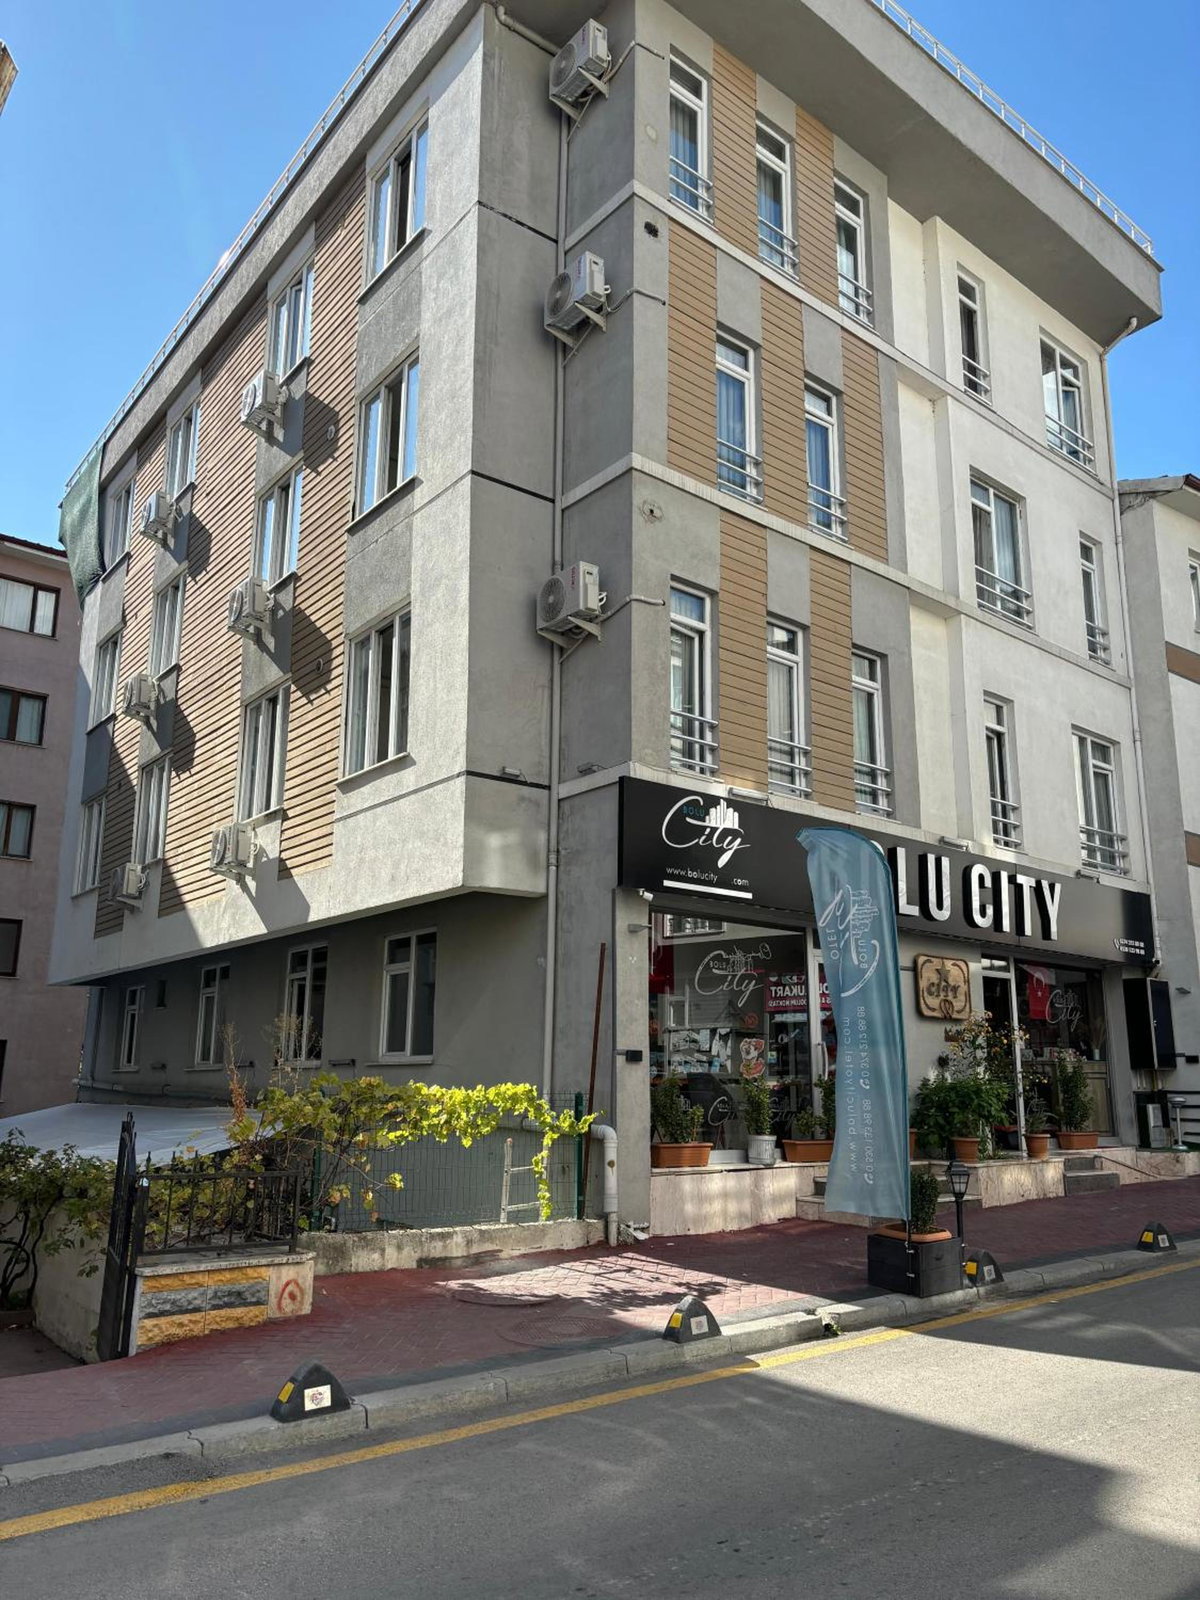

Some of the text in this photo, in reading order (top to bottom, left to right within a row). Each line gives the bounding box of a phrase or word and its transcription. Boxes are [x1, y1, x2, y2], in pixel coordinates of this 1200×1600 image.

[662, 795, 751, 868] City
[683, 805, 705, 816] BOLU
[666, 867, 718, 884] www.bolucity
[964, 863, 1061, 941] CITY
[695, 950, 764, 1008] City
